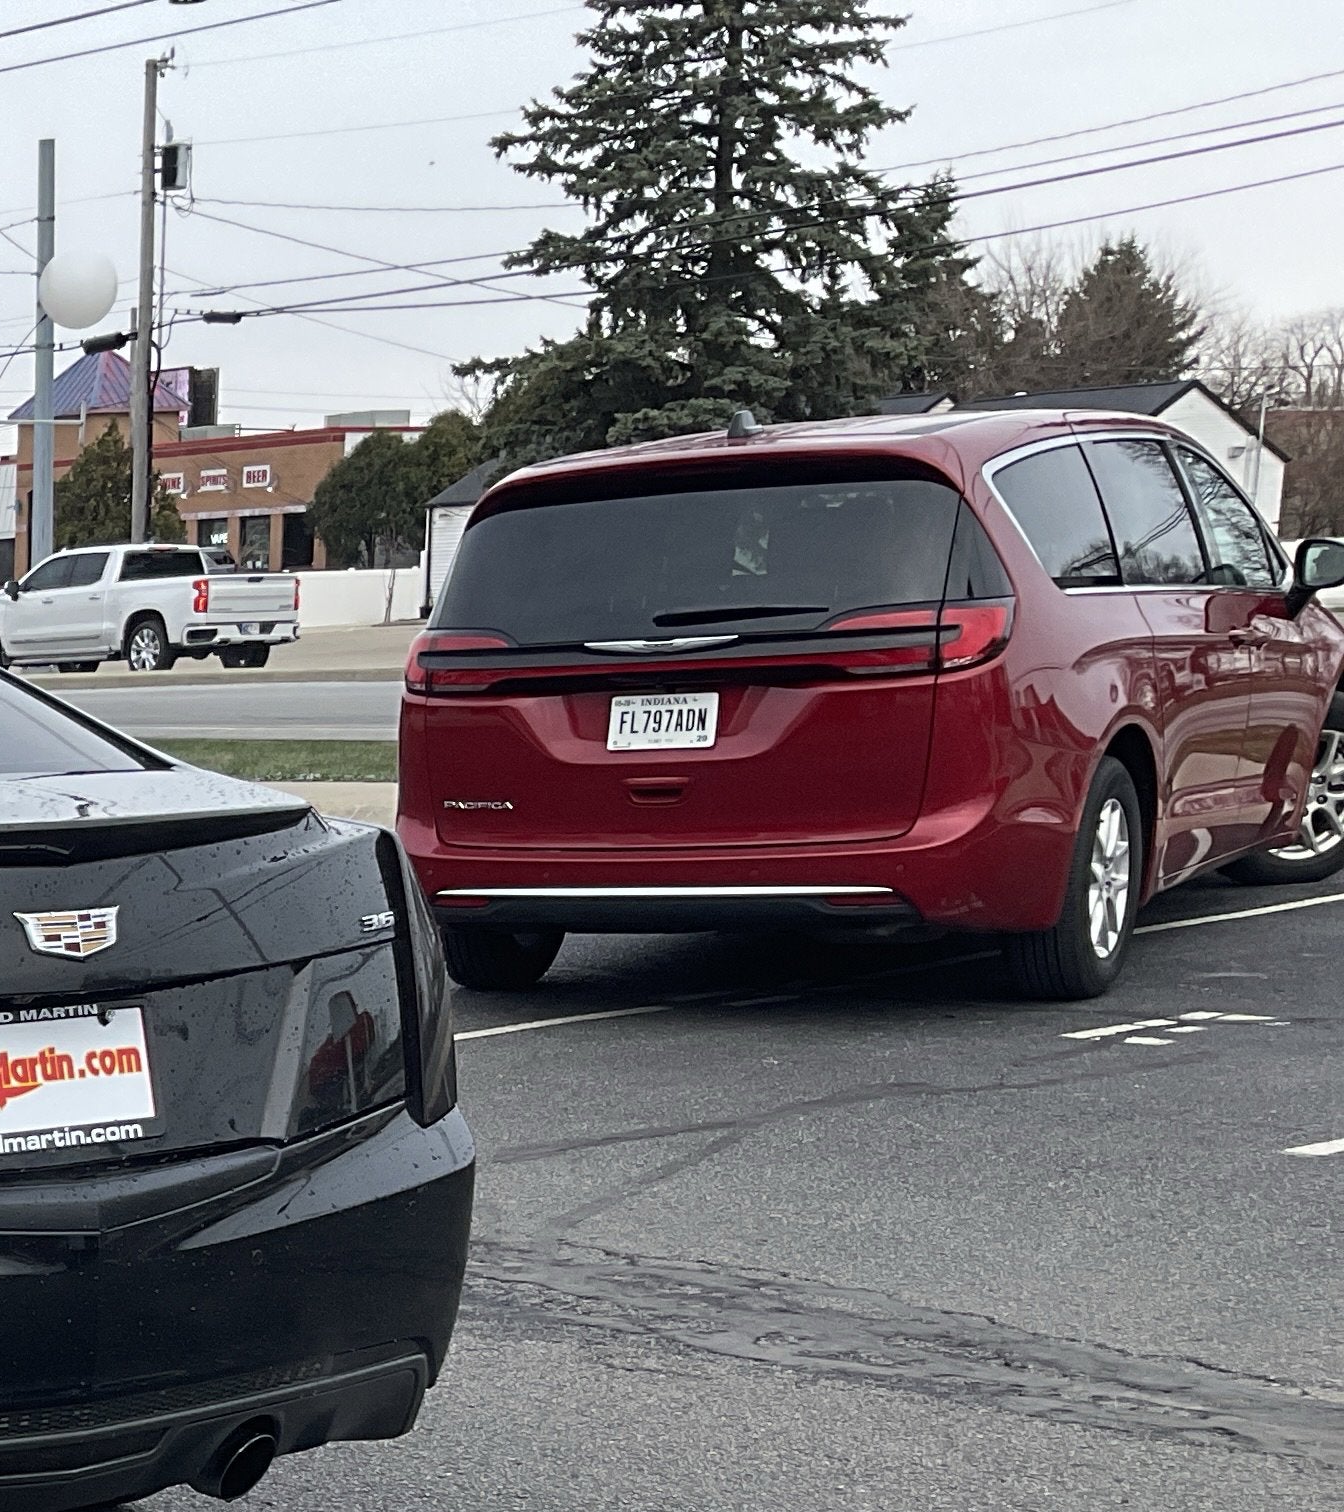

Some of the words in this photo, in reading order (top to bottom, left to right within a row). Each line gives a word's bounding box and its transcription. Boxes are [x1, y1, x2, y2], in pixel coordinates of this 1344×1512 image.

[201, 475, 228, 486] SPIRITS
[246, 470, 268, 484] BEER
[210, 533, 229, 544] VAPE
[640, 697, 688, 706] INDIANA
[619, 708, 708, 734] FL797ADN
[443, 800, 513, 810] PACIFICA
[19, 1004, 98, 1022] MARTIN
